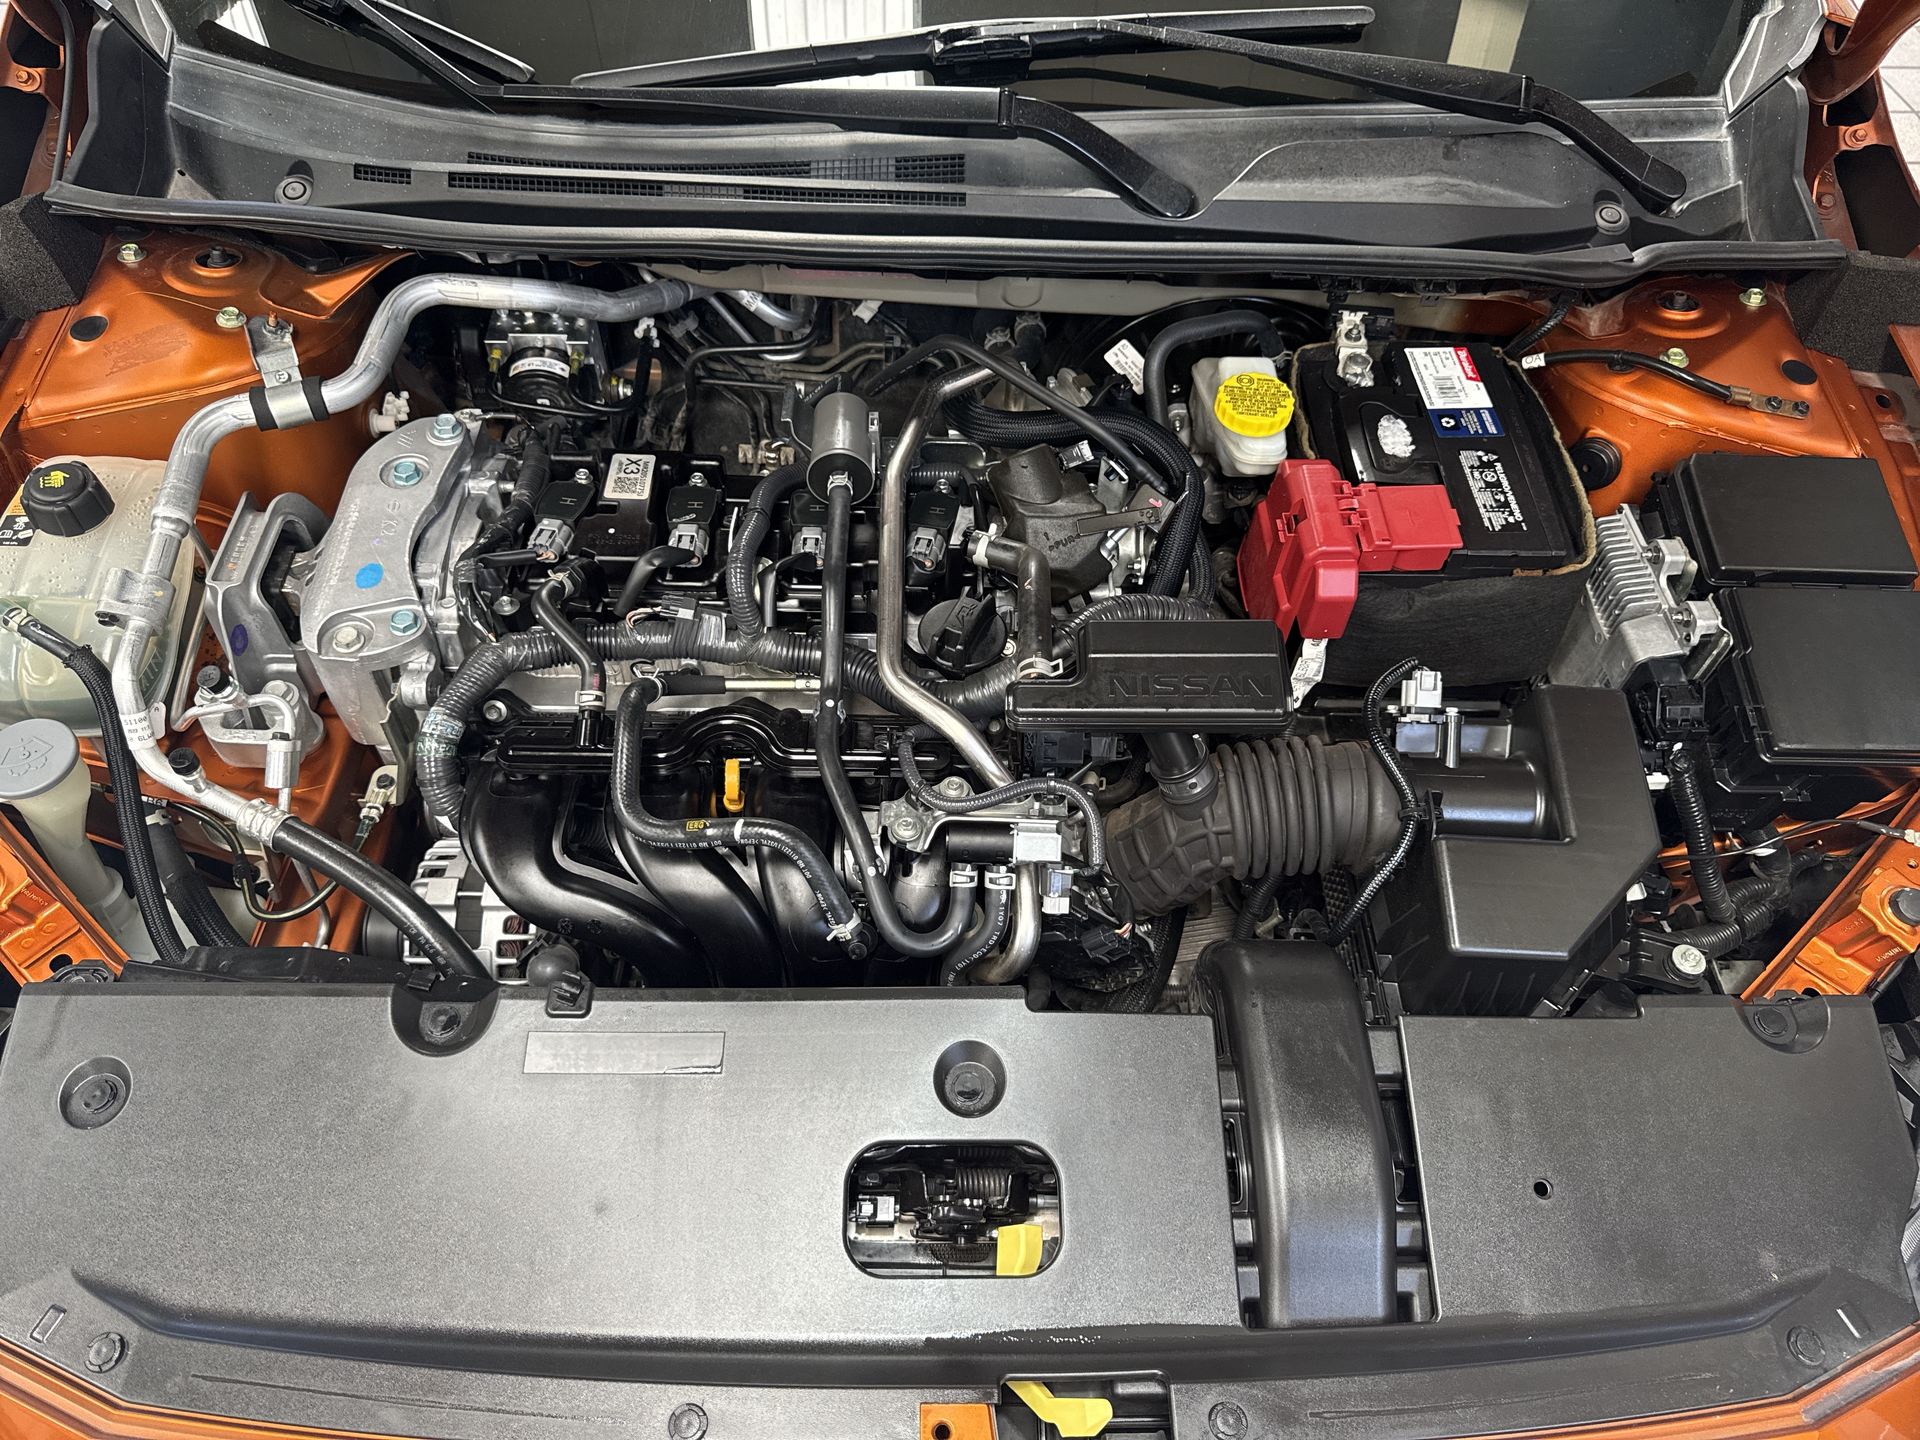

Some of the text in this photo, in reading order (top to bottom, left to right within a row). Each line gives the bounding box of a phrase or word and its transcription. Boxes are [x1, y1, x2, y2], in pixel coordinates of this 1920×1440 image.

[623, 458, 643, 475] X3
[1494, 462, 1524, 521] PELIGRO/VENENO
[1108, 673, 1273, 698] NISSAN
